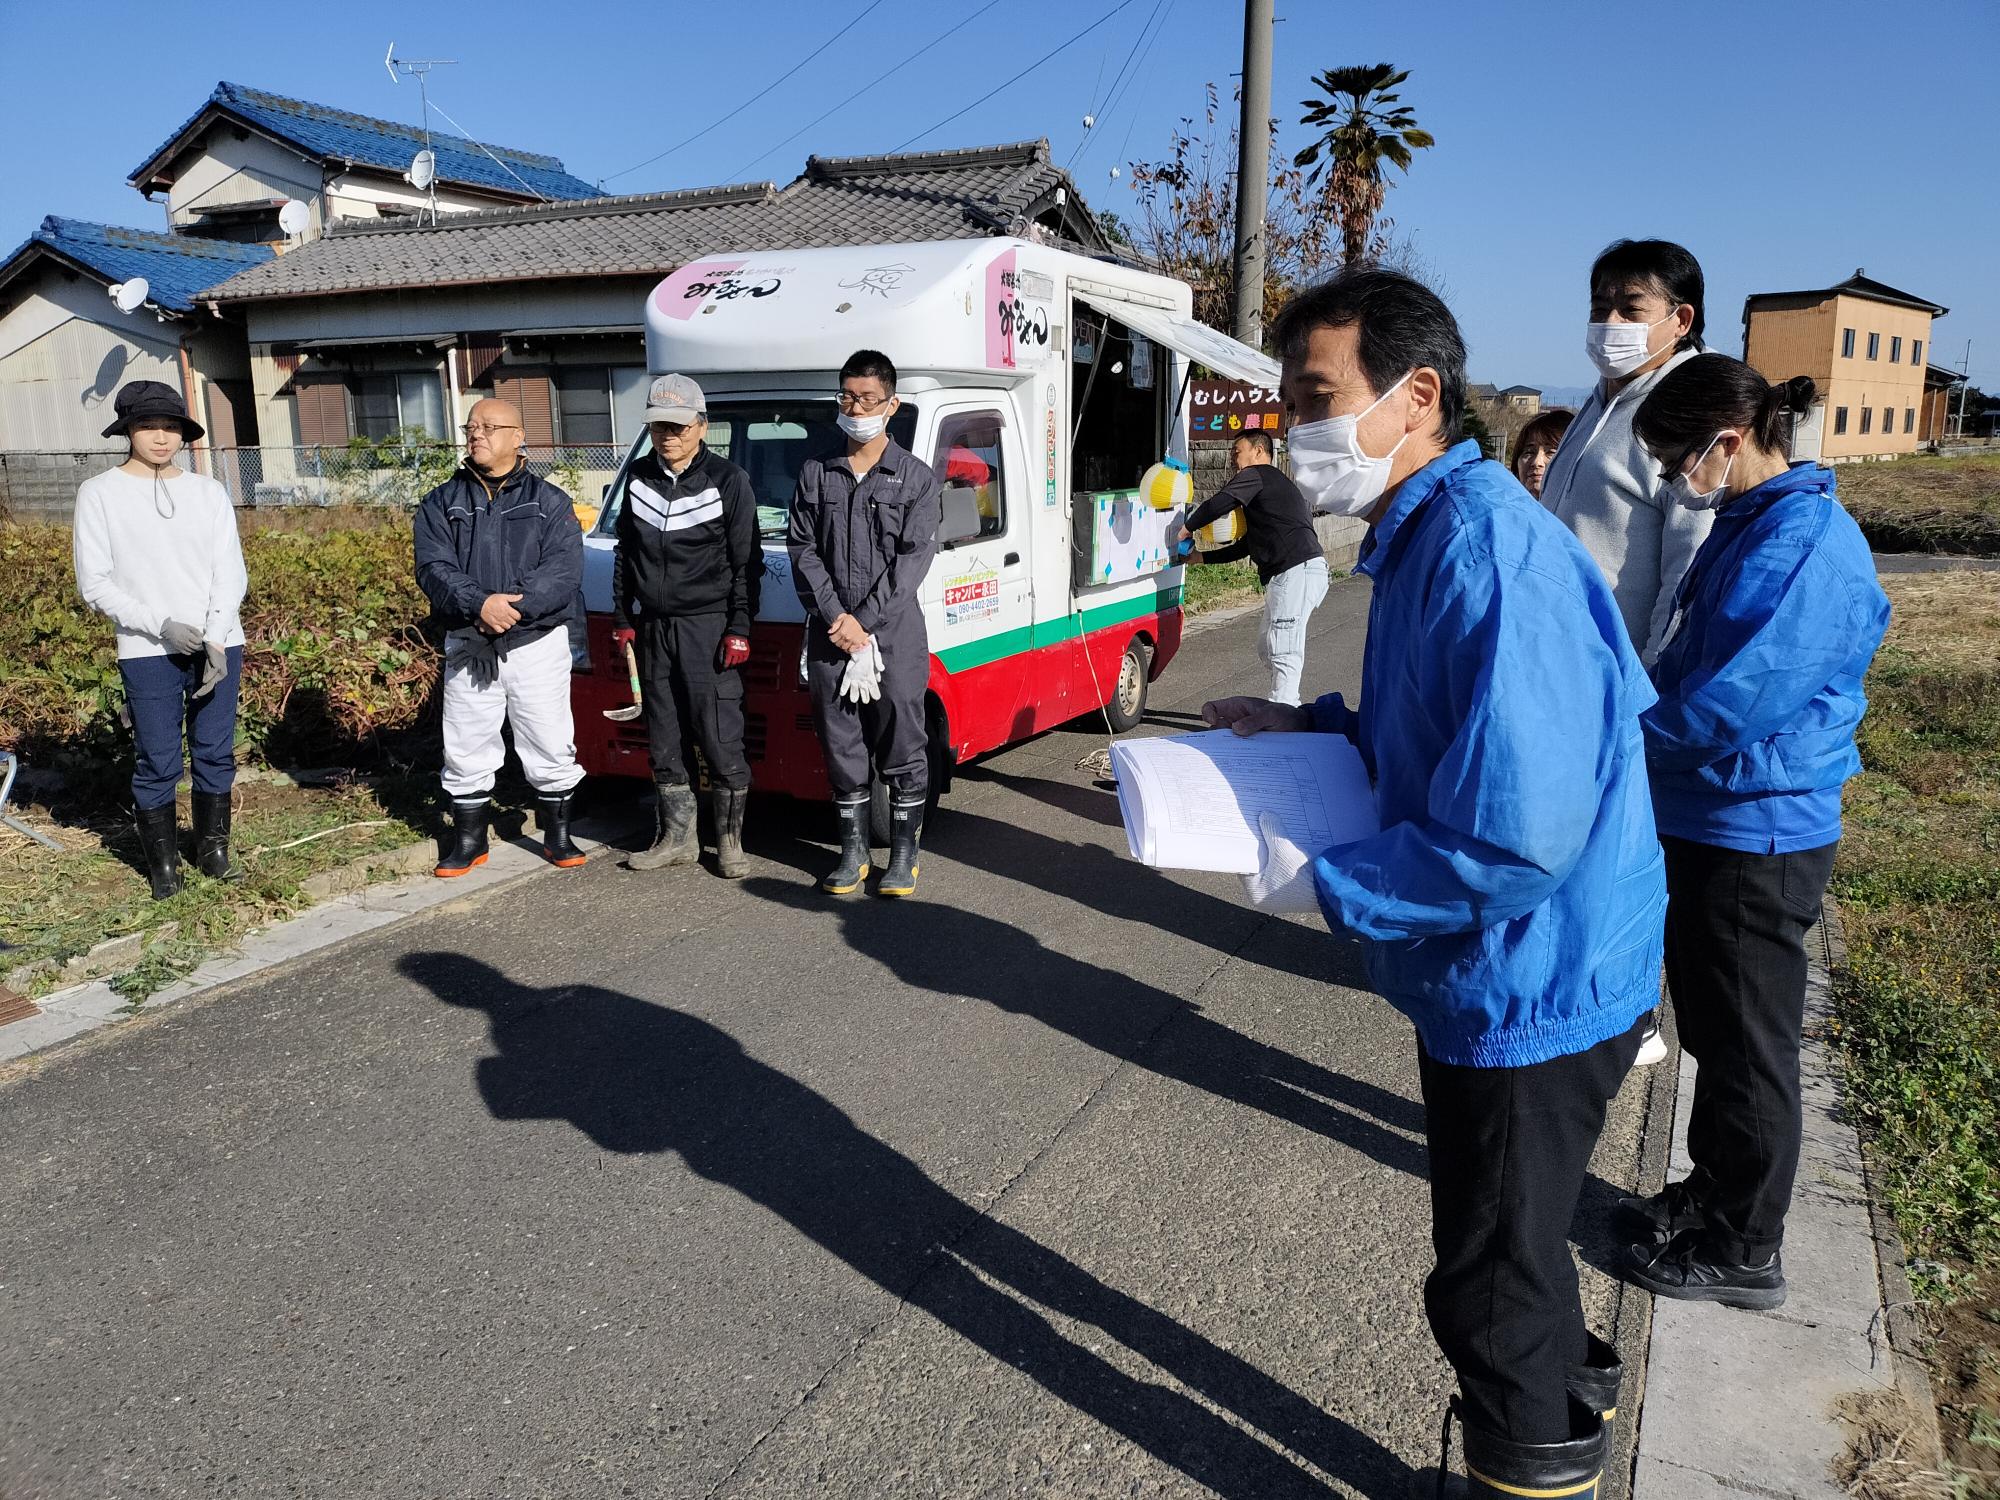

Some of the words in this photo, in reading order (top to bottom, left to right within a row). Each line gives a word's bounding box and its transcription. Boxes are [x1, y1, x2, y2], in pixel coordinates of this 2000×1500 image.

[1073, 317, 1092, 341] PEN
[1190, 389, 1281, 405] むしハウス
[1193, 413, 1279, 431] こども農園
